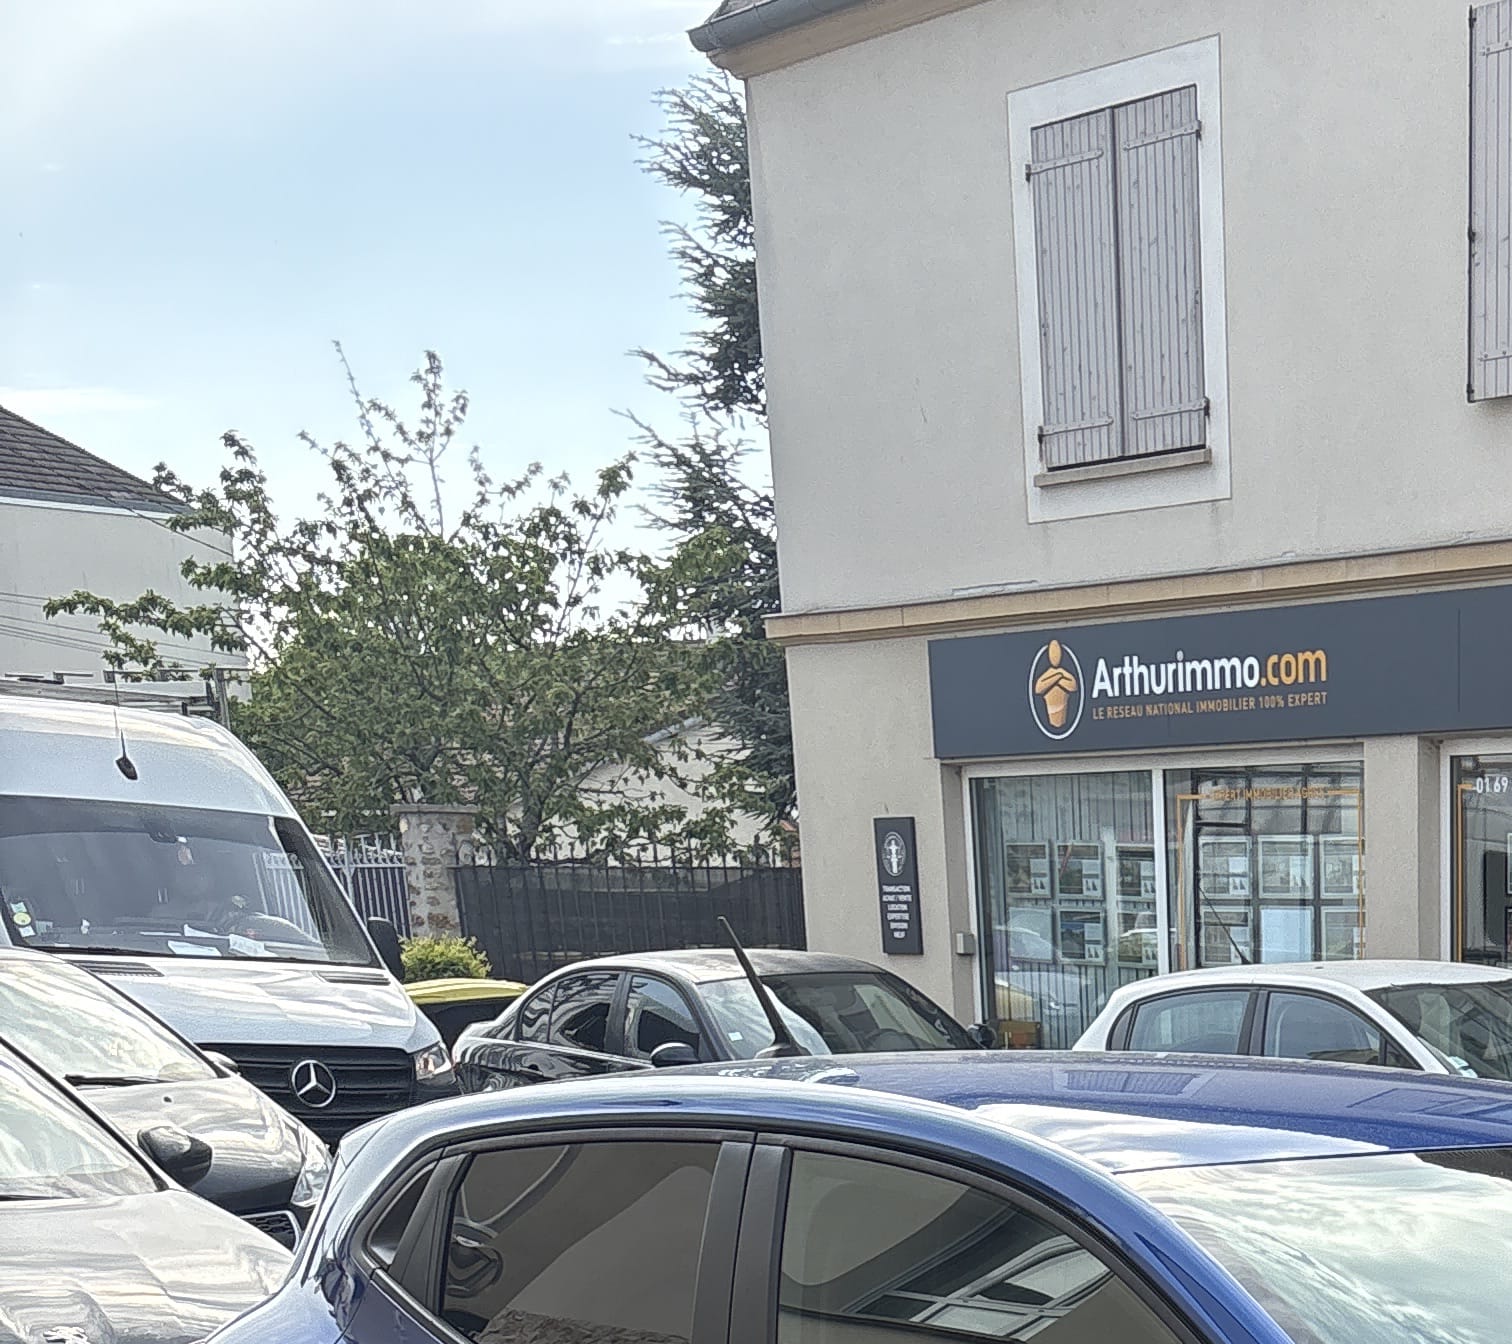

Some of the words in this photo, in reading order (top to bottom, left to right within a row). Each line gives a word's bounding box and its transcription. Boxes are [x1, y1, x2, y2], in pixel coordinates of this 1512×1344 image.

[1092, 649, 1327, 698] Arthurimmo.com
[1092, 706, 1105, 720] LE
[1107, 704, 1143, 719] RESEAU
[1146, 701, 1193, 717] NATIONAL
[1196, 698, 1256, 713] IMMOBILIER
[1259, 695, 1285, 709] 100%
[1288, 692, 1328, 707] EXPERT
[1476, 777, 1490, 793] 01
[1493, 776, 1508, 792] 69
